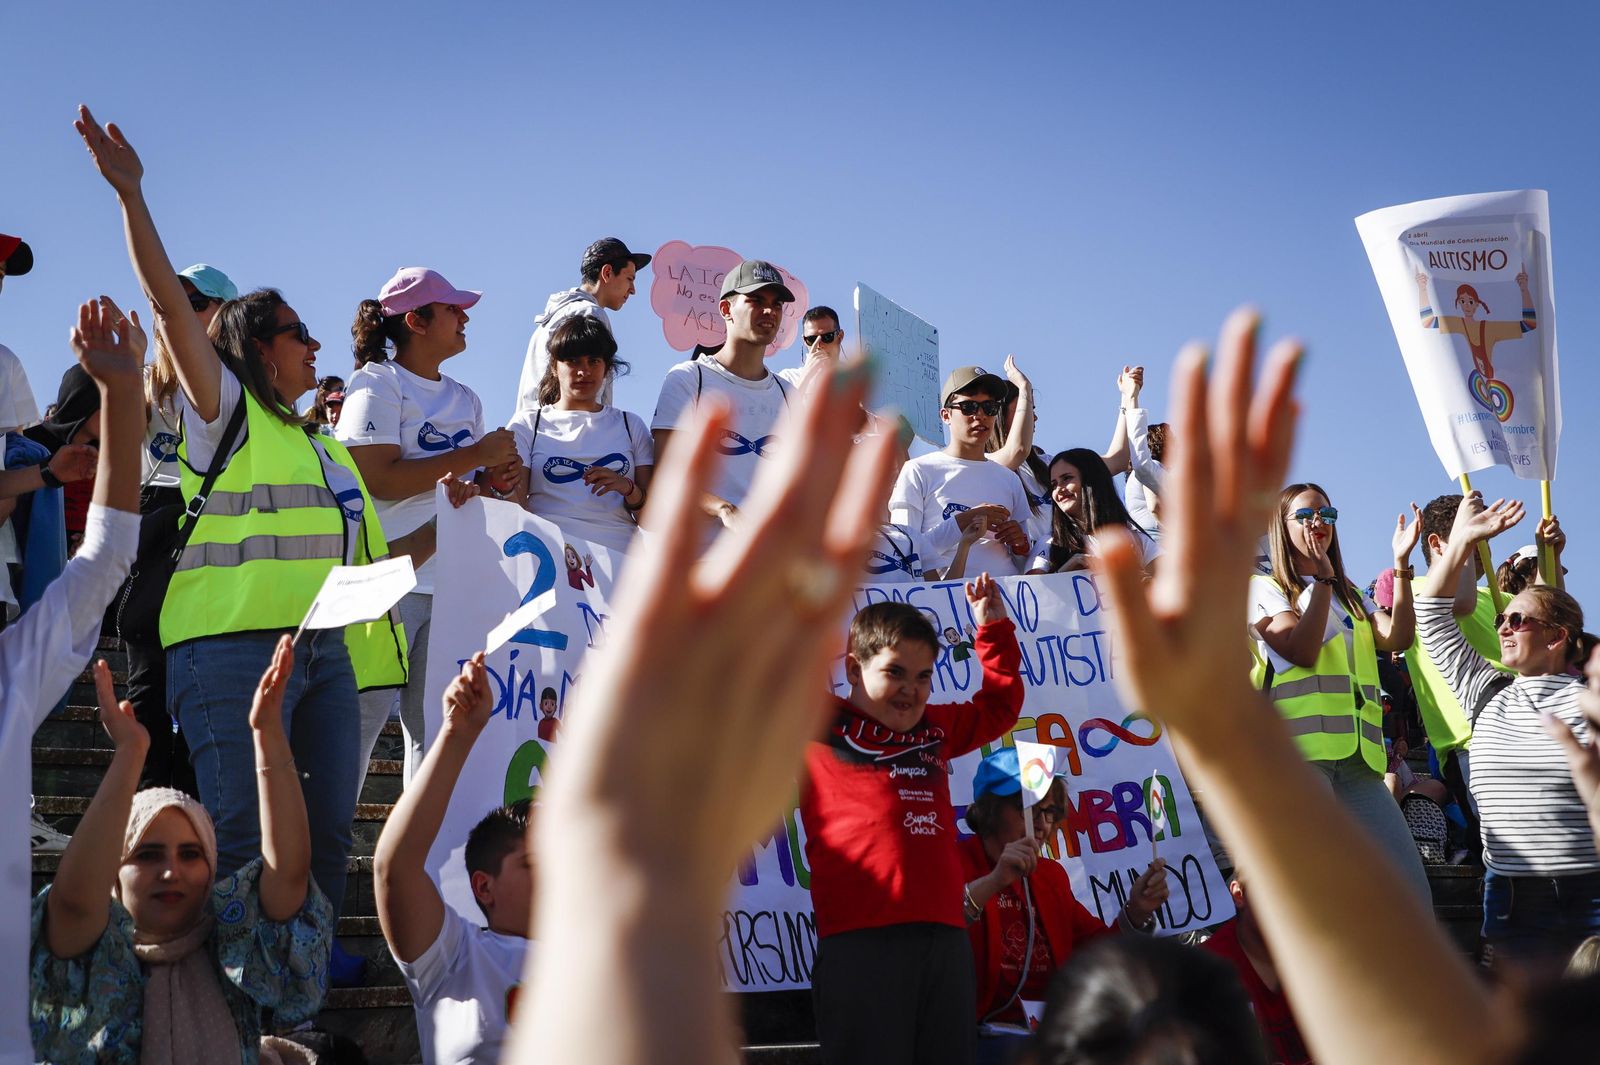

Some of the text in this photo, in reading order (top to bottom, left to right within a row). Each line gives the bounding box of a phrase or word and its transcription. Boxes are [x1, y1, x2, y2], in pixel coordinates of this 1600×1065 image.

[1428, 249, 1508, 271] AUTISMO
[667, 264, 695, 284] LA
[676, 284, 715, 303] No es
[1470, 441, 1487, 455] IES
[544, 458, 575, 473] AULAS TEA
[503, 531, 568, 651] 2
[911, 827, 937, 836] UNIQUE
